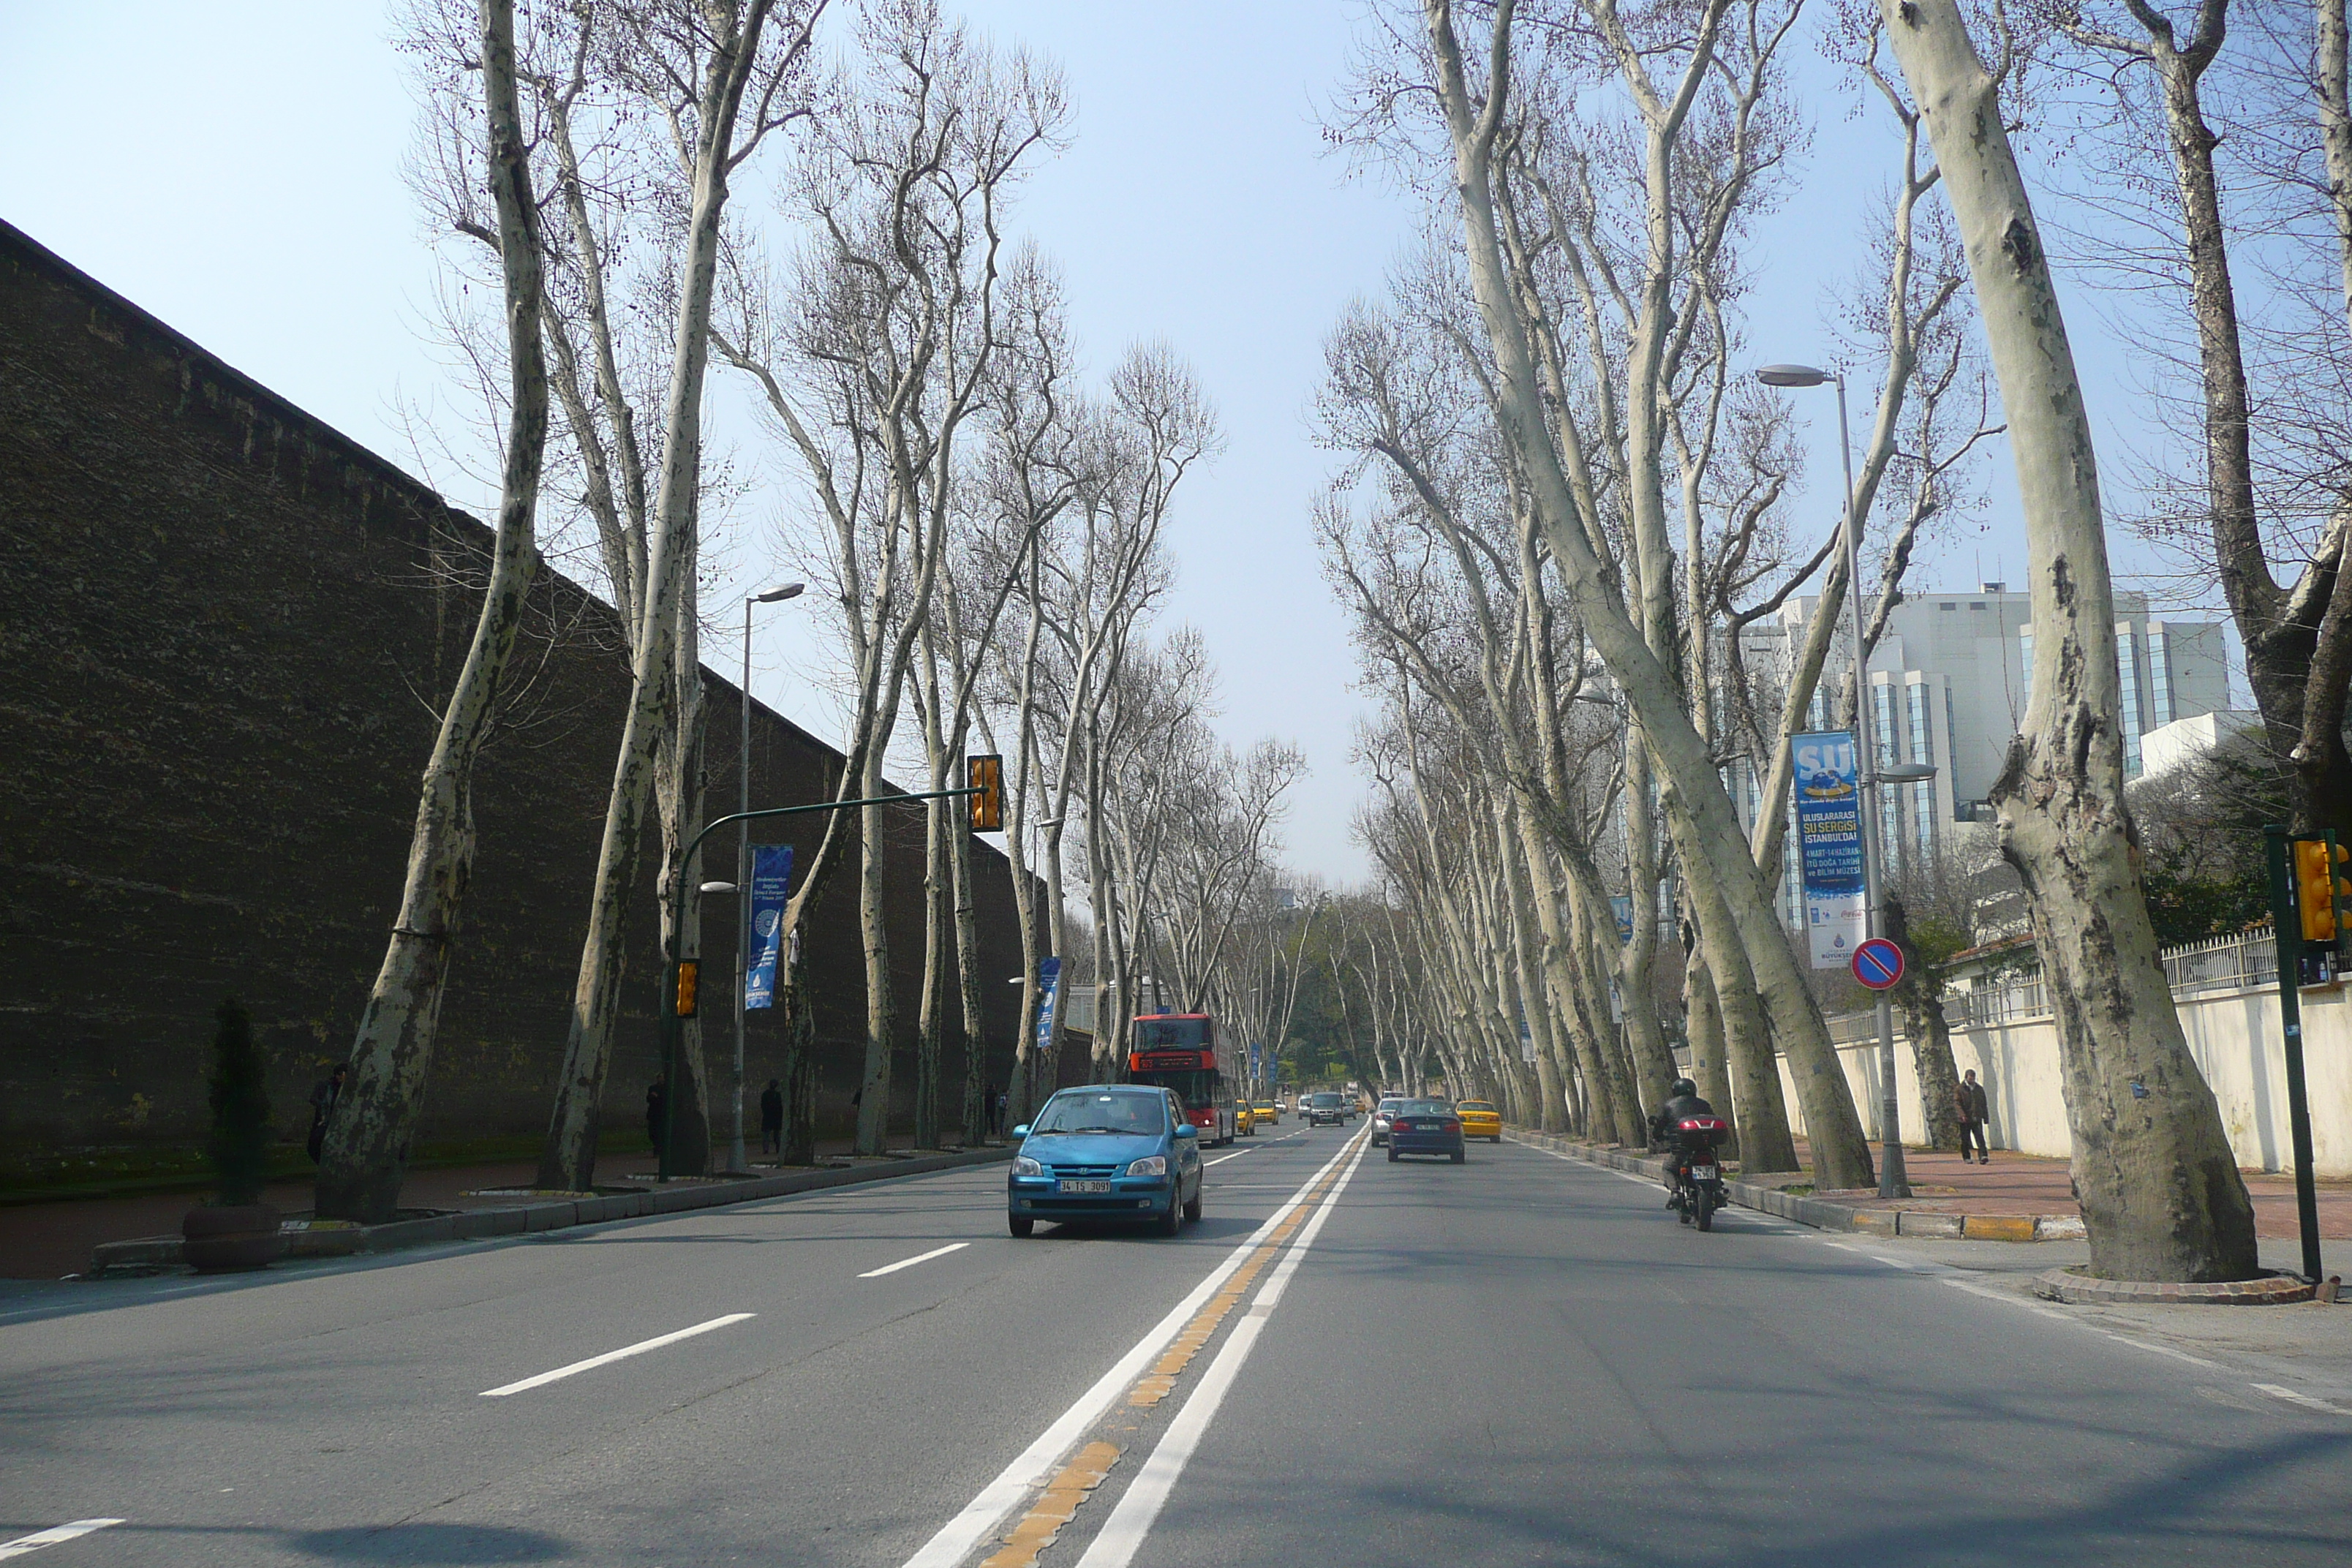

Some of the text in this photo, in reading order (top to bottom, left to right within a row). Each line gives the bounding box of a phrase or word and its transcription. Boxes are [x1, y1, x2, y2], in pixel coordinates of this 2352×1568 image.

[1797, 743, 1852, 780] SU
[1803, 811, 1855, 822] ULUSLARARASI
[1803, 819, 1856, 834] SU SERGİSİ
[1819, 858, 1837, 867] DOĞA
[1839, 856, 1860, 866] TARİHİ
[1836, 866, 1861, 875] MÜZESİ
[1061, 1181, 1109, 1191] 34 TS 3091
